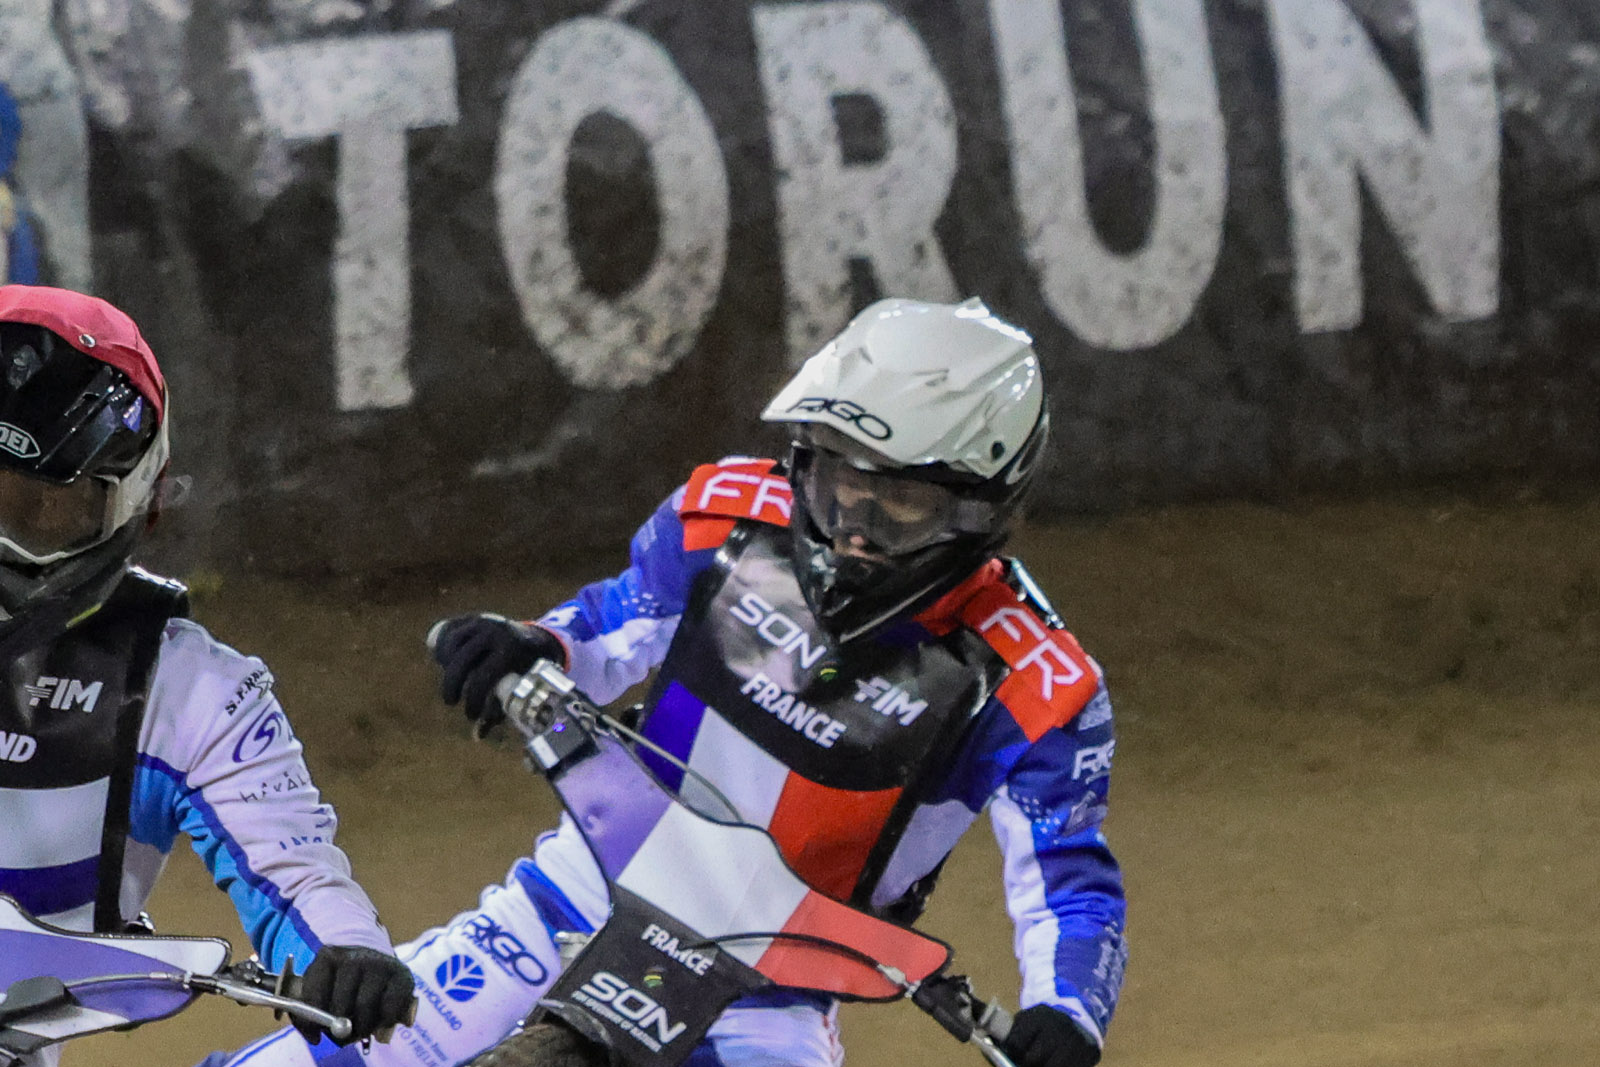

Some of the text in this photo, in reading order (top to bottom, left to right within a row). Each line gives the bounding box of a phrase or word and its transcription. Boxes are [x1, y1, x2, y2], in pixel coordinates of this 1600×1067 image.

[729, 592, 827, 669] SON
[980, 607, 1084, 701] FR
[24, 676, 104, 713] FIM
[740, 672, 847, 750] FRANCE
[854, 676, 929, 727] FIM
[641, 923, 714, 976] FRANCE
[581, 971, 687, 1044] SON
